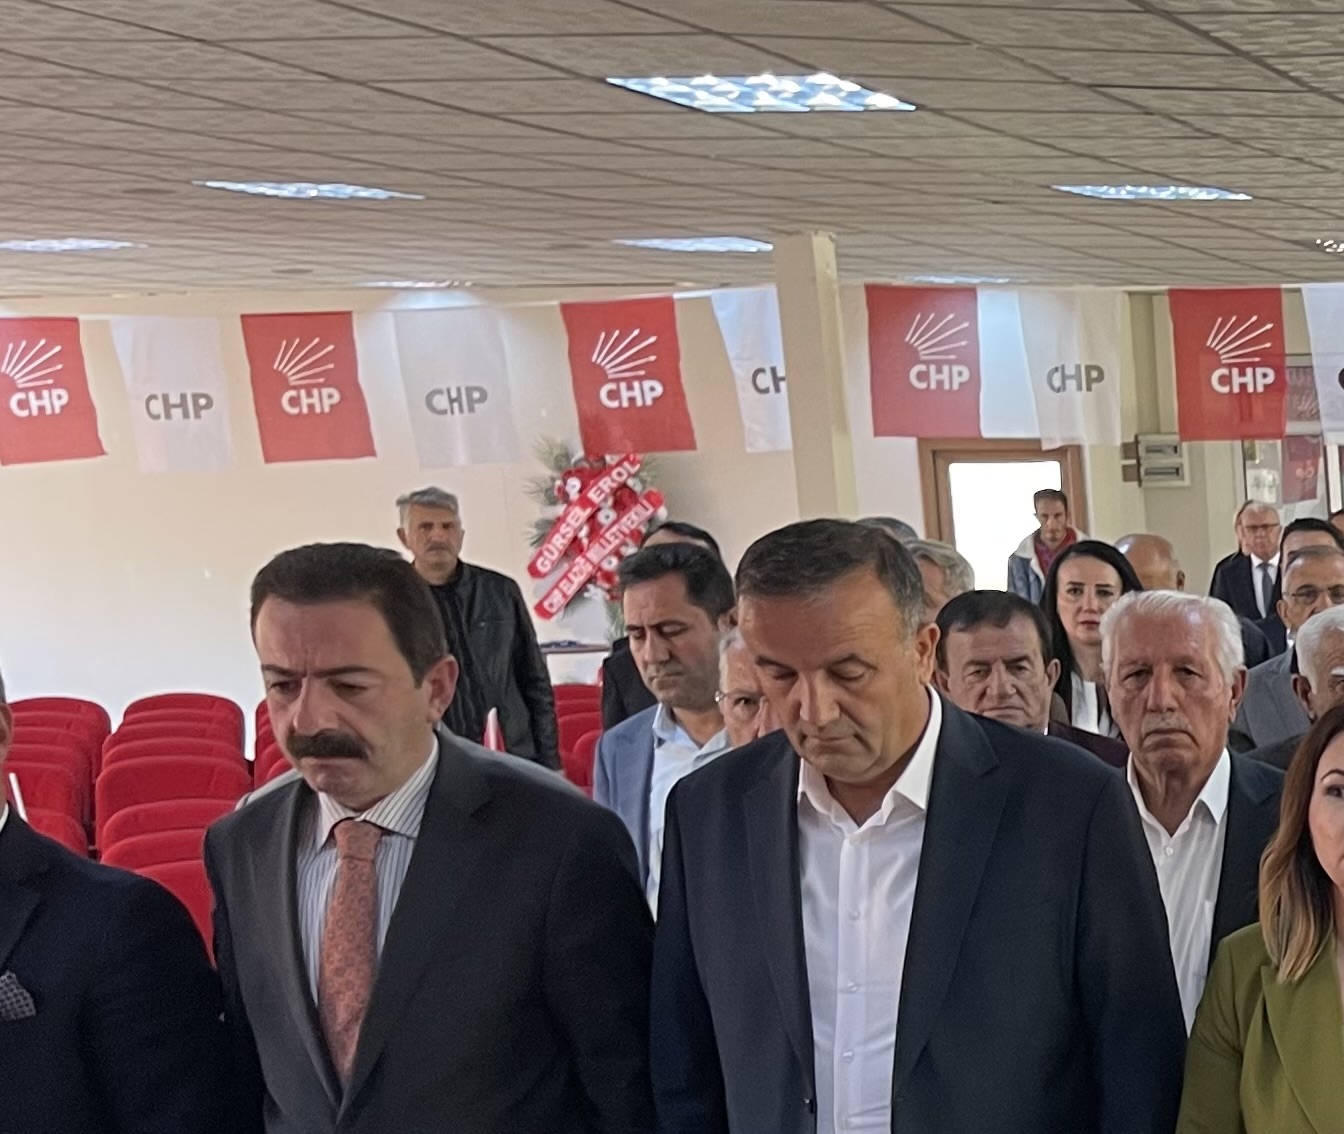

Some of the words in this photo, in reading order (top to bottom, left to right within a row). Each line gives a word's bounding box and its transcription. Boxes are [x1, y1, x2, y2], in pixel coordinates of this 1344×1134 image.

[751, 366, 786, 394] CH
[909, 364, 970, 390] CHP
[1047, 364, 1104, 393] CHP
[1211, 367, 1276, 393] CHP
[9, 388, 69, 417] CHP
[145, 392, 214, 420] CHP
[281, 387, 341, 415] CHP
[425, 386, 488, 415] CHP
[600, 380, 663, 408] CHP
[587, 461, 641, 504] EROL
